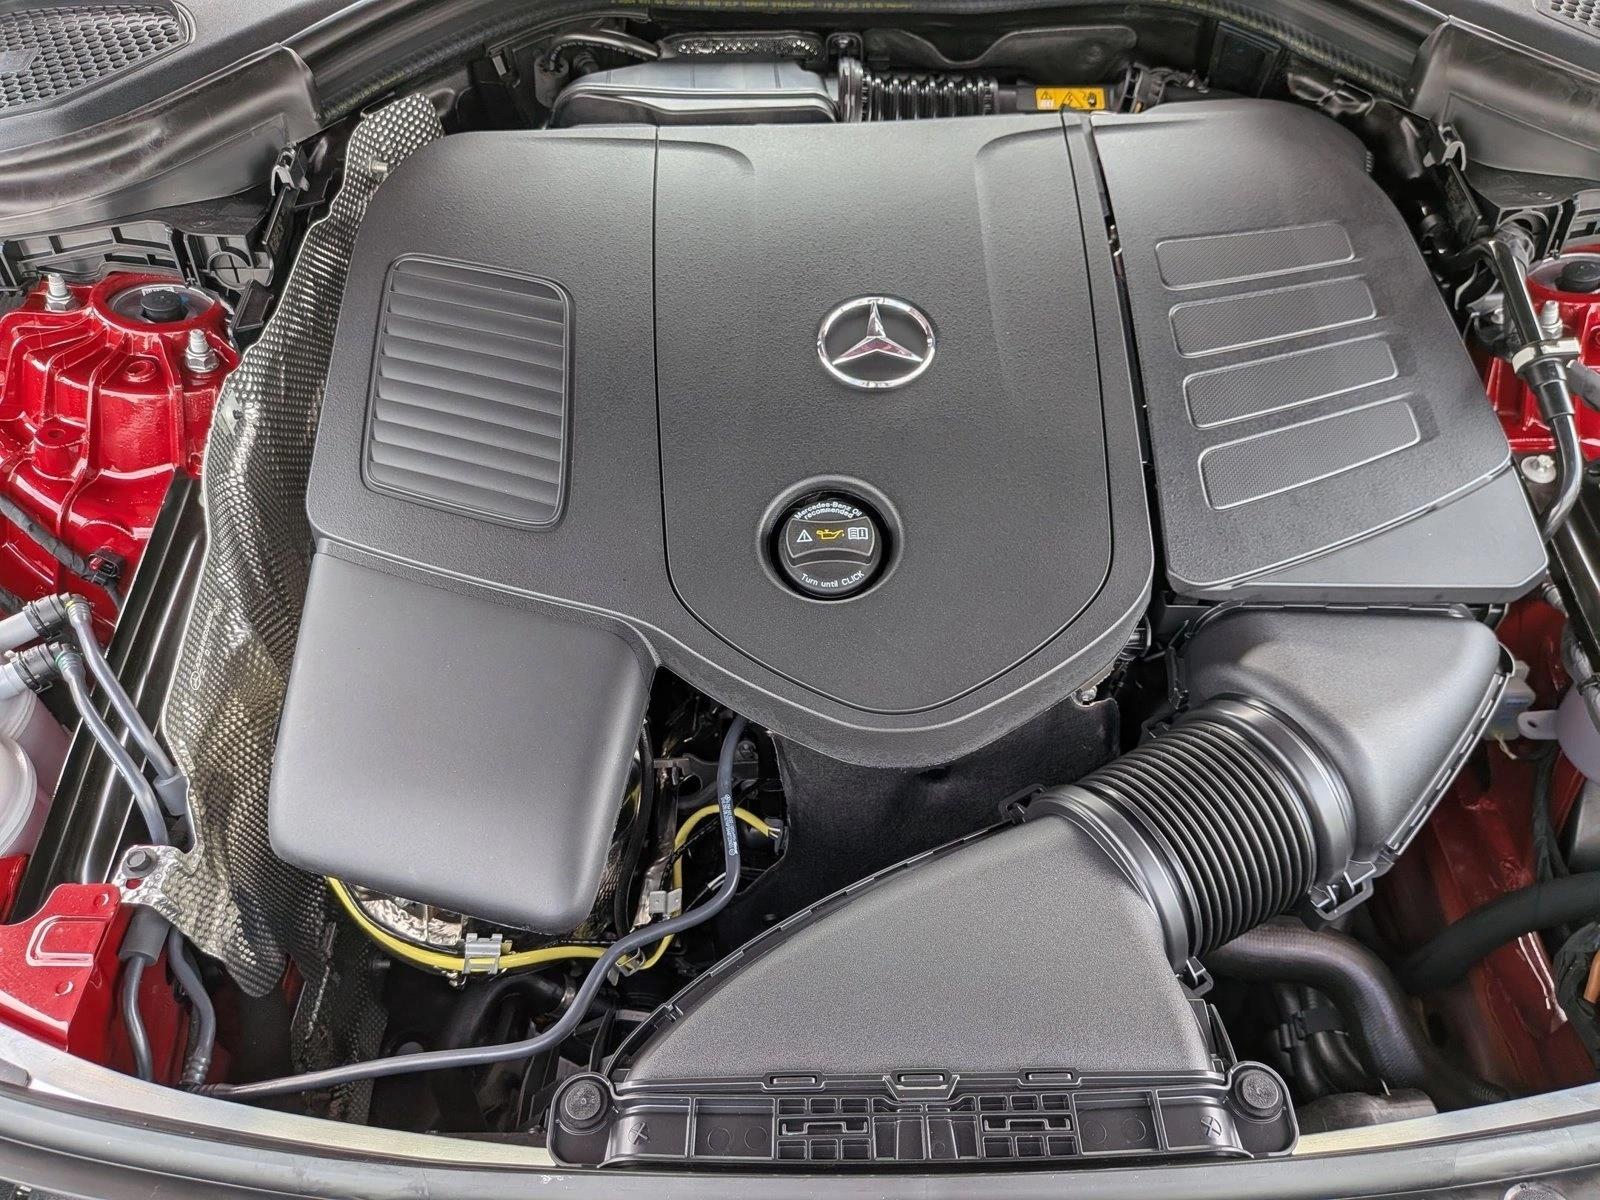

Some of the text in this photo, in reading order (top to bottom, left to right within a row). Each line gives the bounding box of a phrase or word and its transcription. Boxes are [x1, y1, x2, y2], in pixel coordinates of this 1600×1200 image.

[794, 502, 862, 519] Mercedes-Benz Oil
[804, 507, 854, 520] recommended
[801, 573, 818, 585] Turn
[841, 571, 864, 585] CLICK
